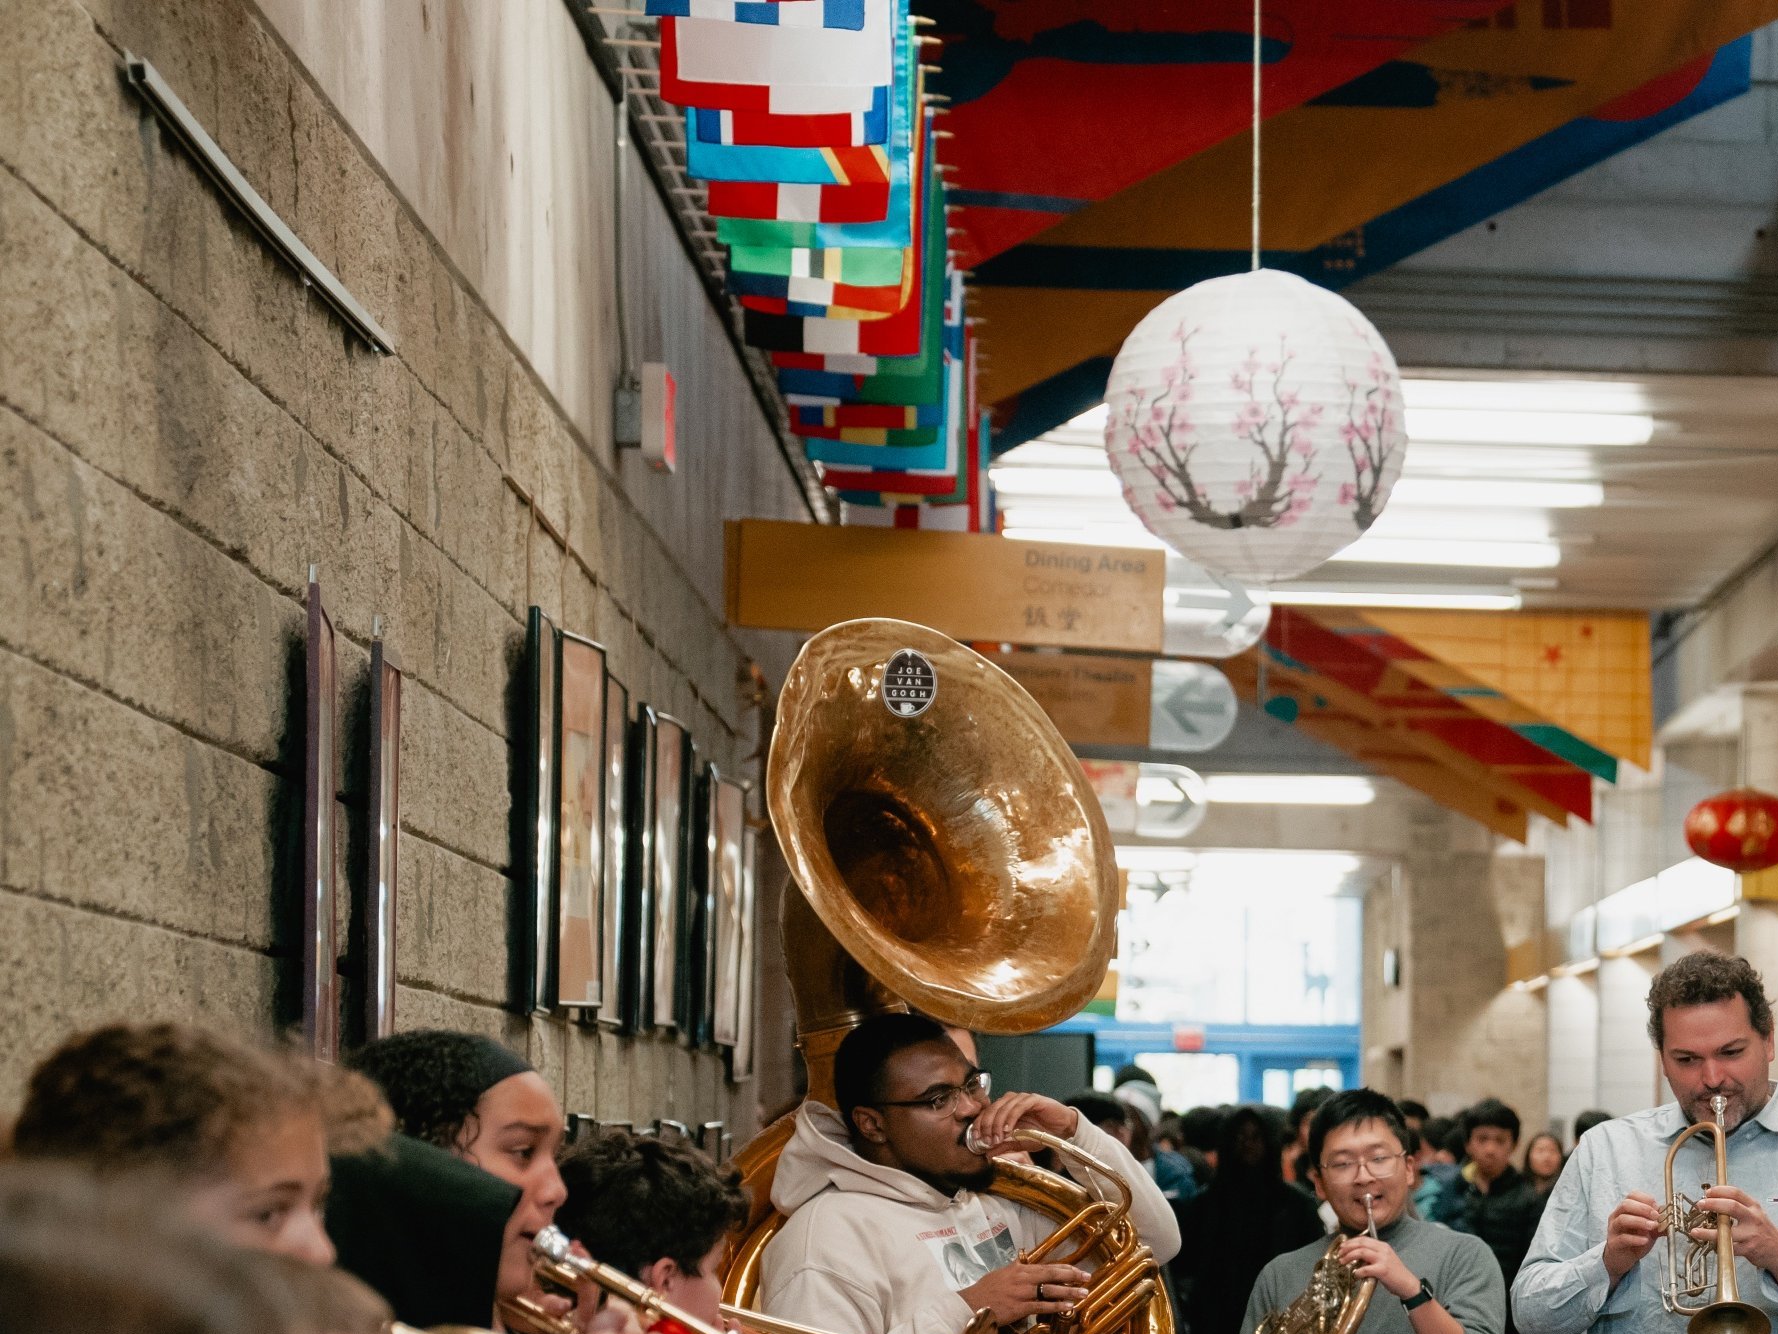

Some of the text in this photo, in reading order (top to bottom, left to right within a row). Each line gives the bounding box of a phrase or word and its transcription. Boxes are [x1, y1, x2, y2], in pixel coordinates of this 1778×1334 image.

[1025, 549, 1147, 574] Dining Area
[1023, 575, 1112, 598] Comedor
[898, 667, 921, 675] JOE
[897, 677, 921, 686] VAN
[891, 689, 926, 698] GOGH
